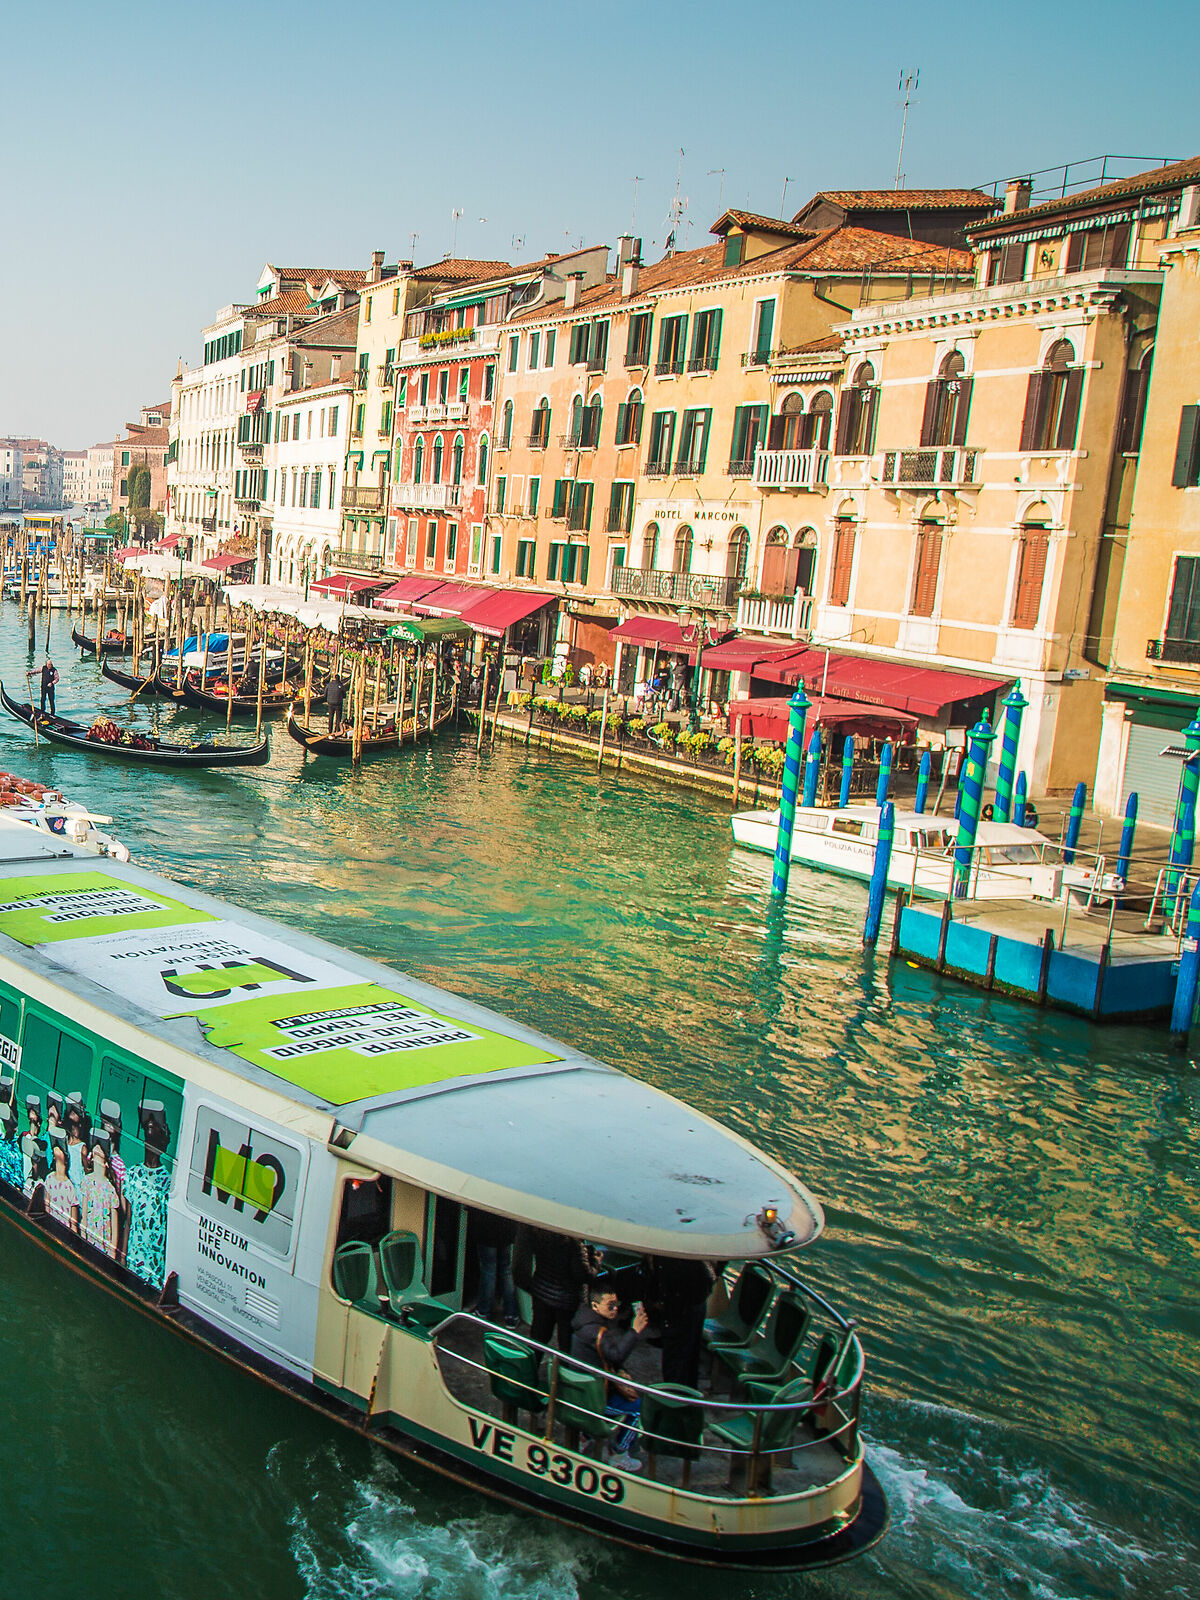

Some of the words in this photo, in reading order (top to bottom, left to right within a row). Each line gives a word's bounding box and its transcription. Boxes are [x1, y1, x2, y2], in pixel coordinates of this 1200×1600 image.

[655, 510, 682, 519] HOTEL
[694, 511, 739, 521] MARCONI
[824, 840, 851, 853] POLIZIA
[40, 891, 133, 904] THROUGH
[58, 898, 143, 912] JOURNEY
[109, 904, 161, 914] BOOK
[51, 910, 106, 922] YOUR
[109, 939, 230, 960] INNOVATION
[198, 944, 240, 955] LIFE
[163, 949, 252, 965] MUSEUM
[379, 1001, 404, 1011] SU
[372, 1010, 420, 1023] NEL
[288, 1019, 371, 1038] TEMPO
[371, 1024, 423, 1037] TUO
[423, 1020, 447, 1030] IL
[271, 1032, 374, 1057] VIAGGIO
[362, 1031, 473, 1054] PRENOTA
[201, 1128, 286, 1224] M9
[198, 1229, 221, 1250] LIFE
[199, 1216, 249, 1251] MUSEUM
[198, 1242, 266, 1289] INNOVATION
[468, 1416, 516, 1462] VE
[526, 1444, 625, 1503] 9309
